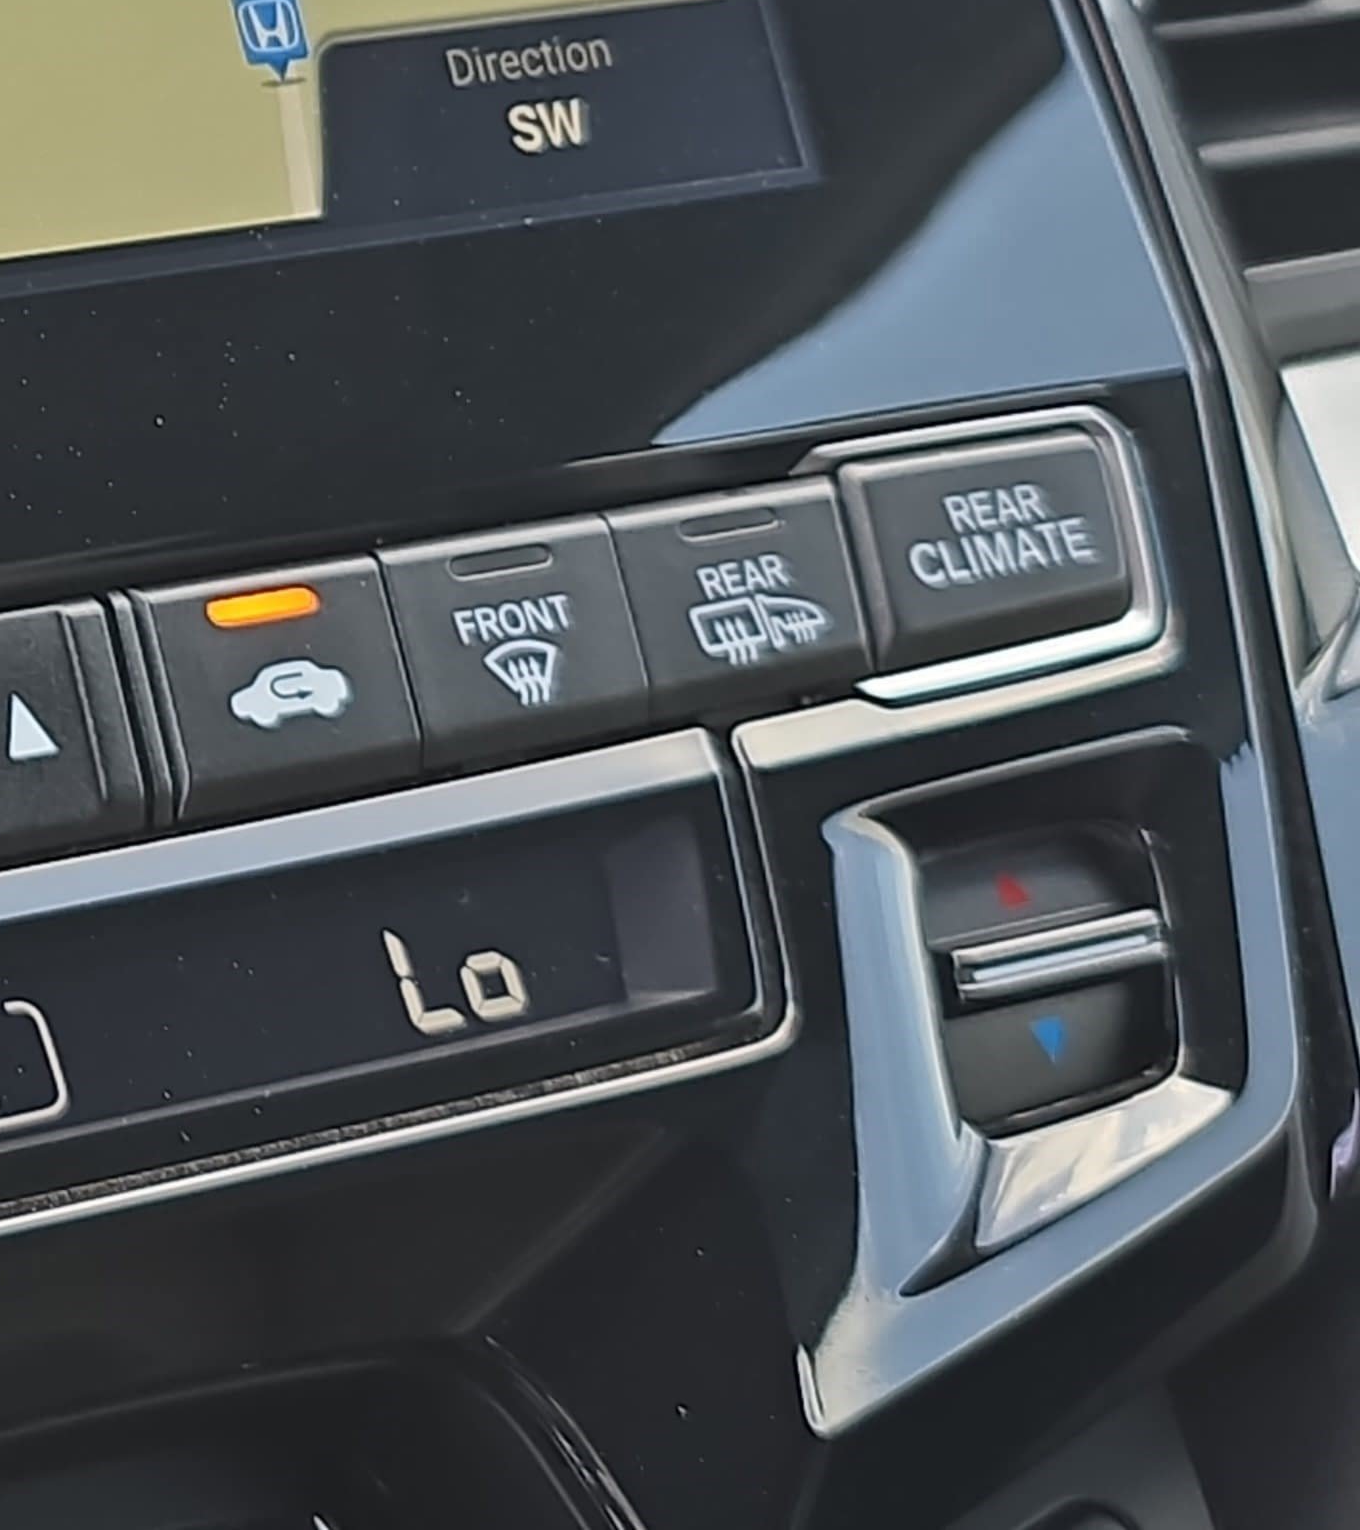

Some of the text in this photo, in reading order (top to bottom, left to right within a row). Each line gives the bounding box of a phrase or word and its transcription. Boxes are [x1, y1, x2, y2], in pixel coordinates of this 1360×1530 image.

[445, 34, 614, 88] Direction
[506, 97, 588, 154] SW
[943, 482, 1049, 532] REAR
[695, 553, 793, 596] REAR
[907, 516, 1098, 590] CLIMATE
[452, 591, 573, 647] FRONT
[381, 927, 530, 1036] Lo
